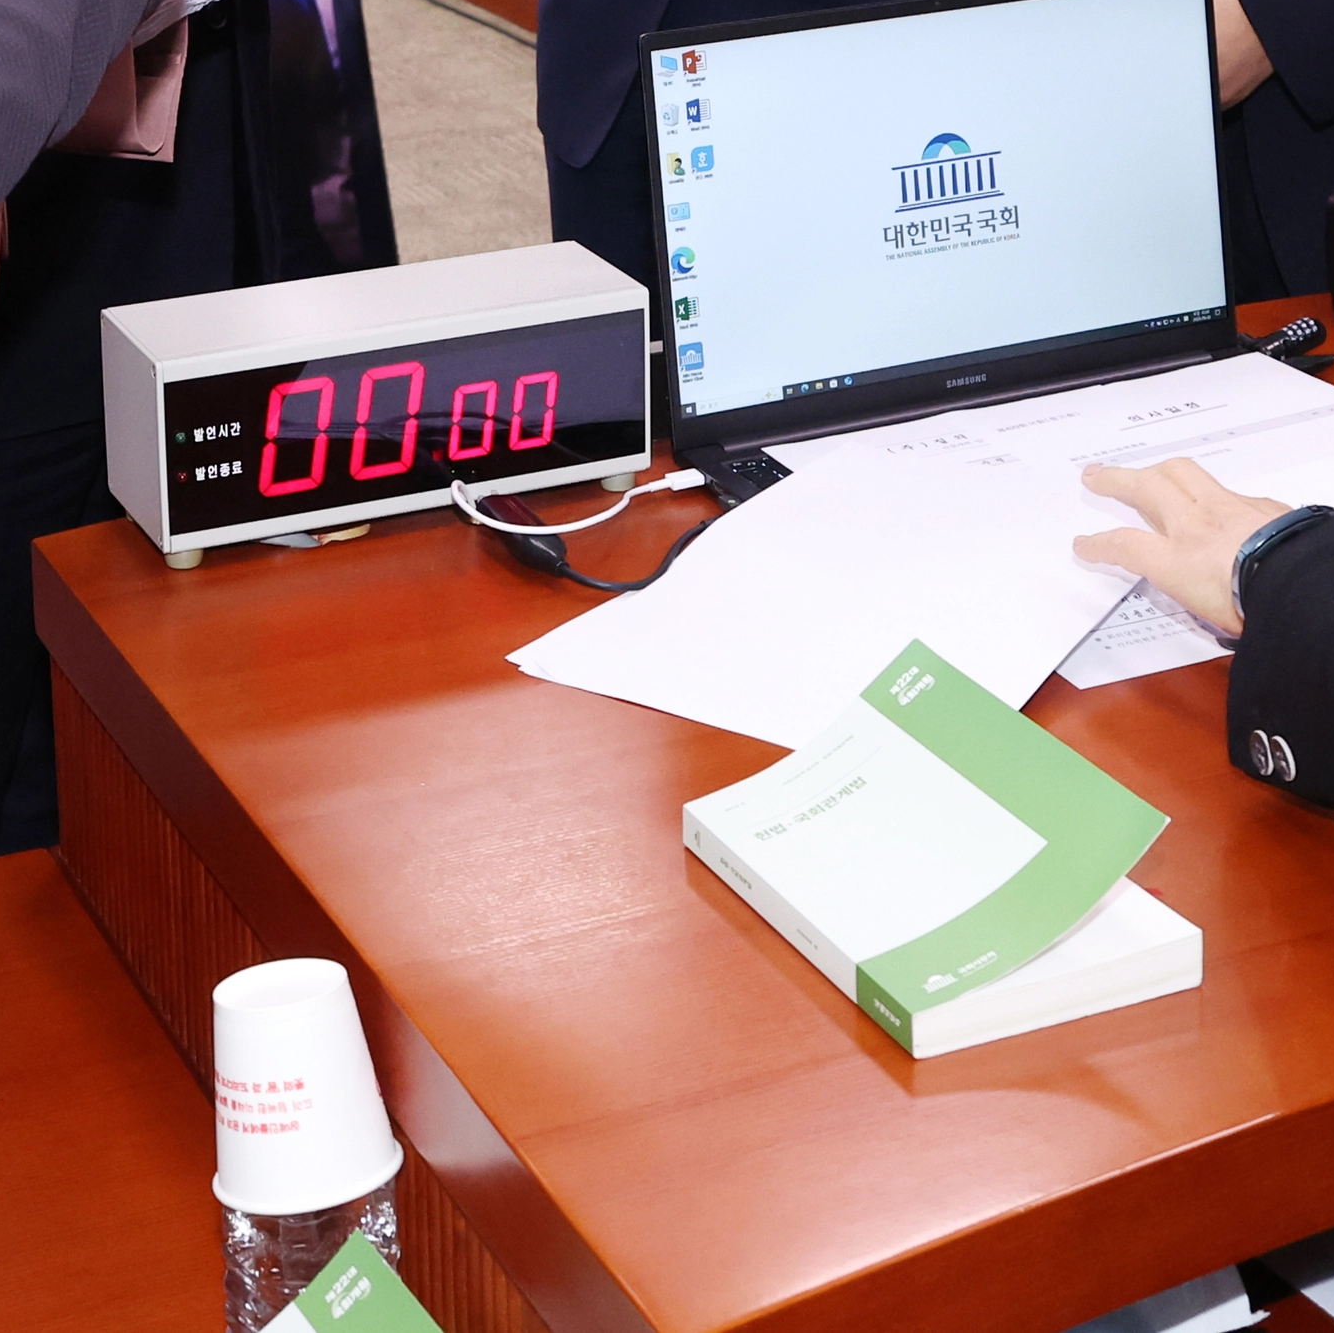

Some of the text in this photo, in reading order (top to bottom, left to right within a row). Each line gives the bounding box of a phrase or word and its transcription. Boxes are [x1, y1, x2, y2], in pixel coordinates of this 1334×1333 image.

[882, 205, 1020, 250] 대한민국 국회
[897, 249, 923, 260] NATIONAL
[924, 245, 952, 255] ASSEMBLY
[970, 237, 995, 247] REPUBLIC
[1003, 233, 1021, 241] KOREA
[946, 373, 987, 389] SAMSUNG
[193, 421, 241, 443] 발언시간
[195, 460, 243, 482] 발언종료
